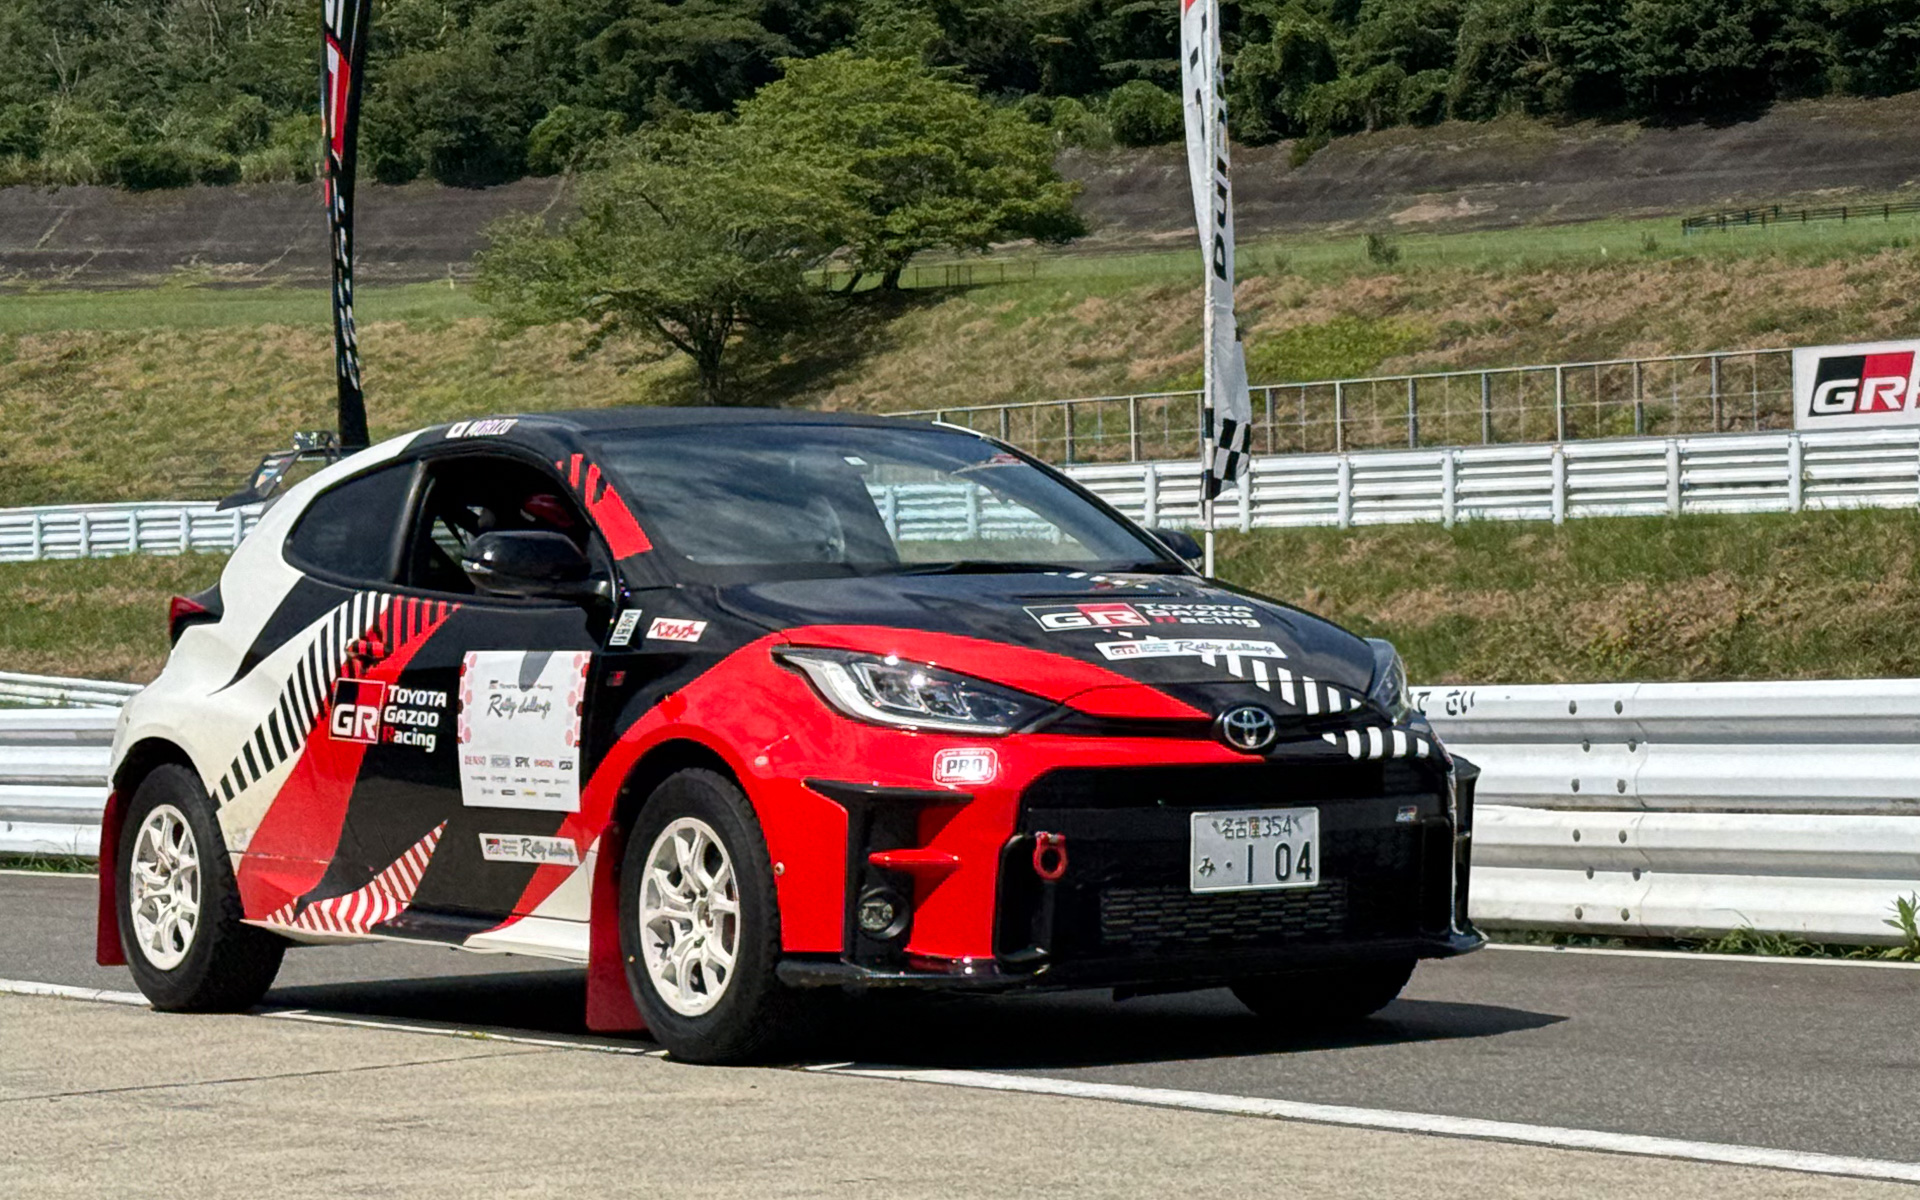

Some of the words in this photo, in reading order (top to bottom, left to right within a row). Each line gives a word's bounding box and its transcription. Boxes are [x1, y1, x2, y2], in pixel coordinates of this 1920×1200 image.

[1812, 376, 1907, 413] GR
[1041, 610, 1147, 628] GR
[1134, 603, 1254, 612] TOYOTA
[1145, 609, 1252, 618] GAZOO
[387, 684, 448, 708] TOYOTA
[332, 703, 379, 740] GR
[383, 705, 440, 727] GAZOO
[382, 725, 436, 753] Racing
